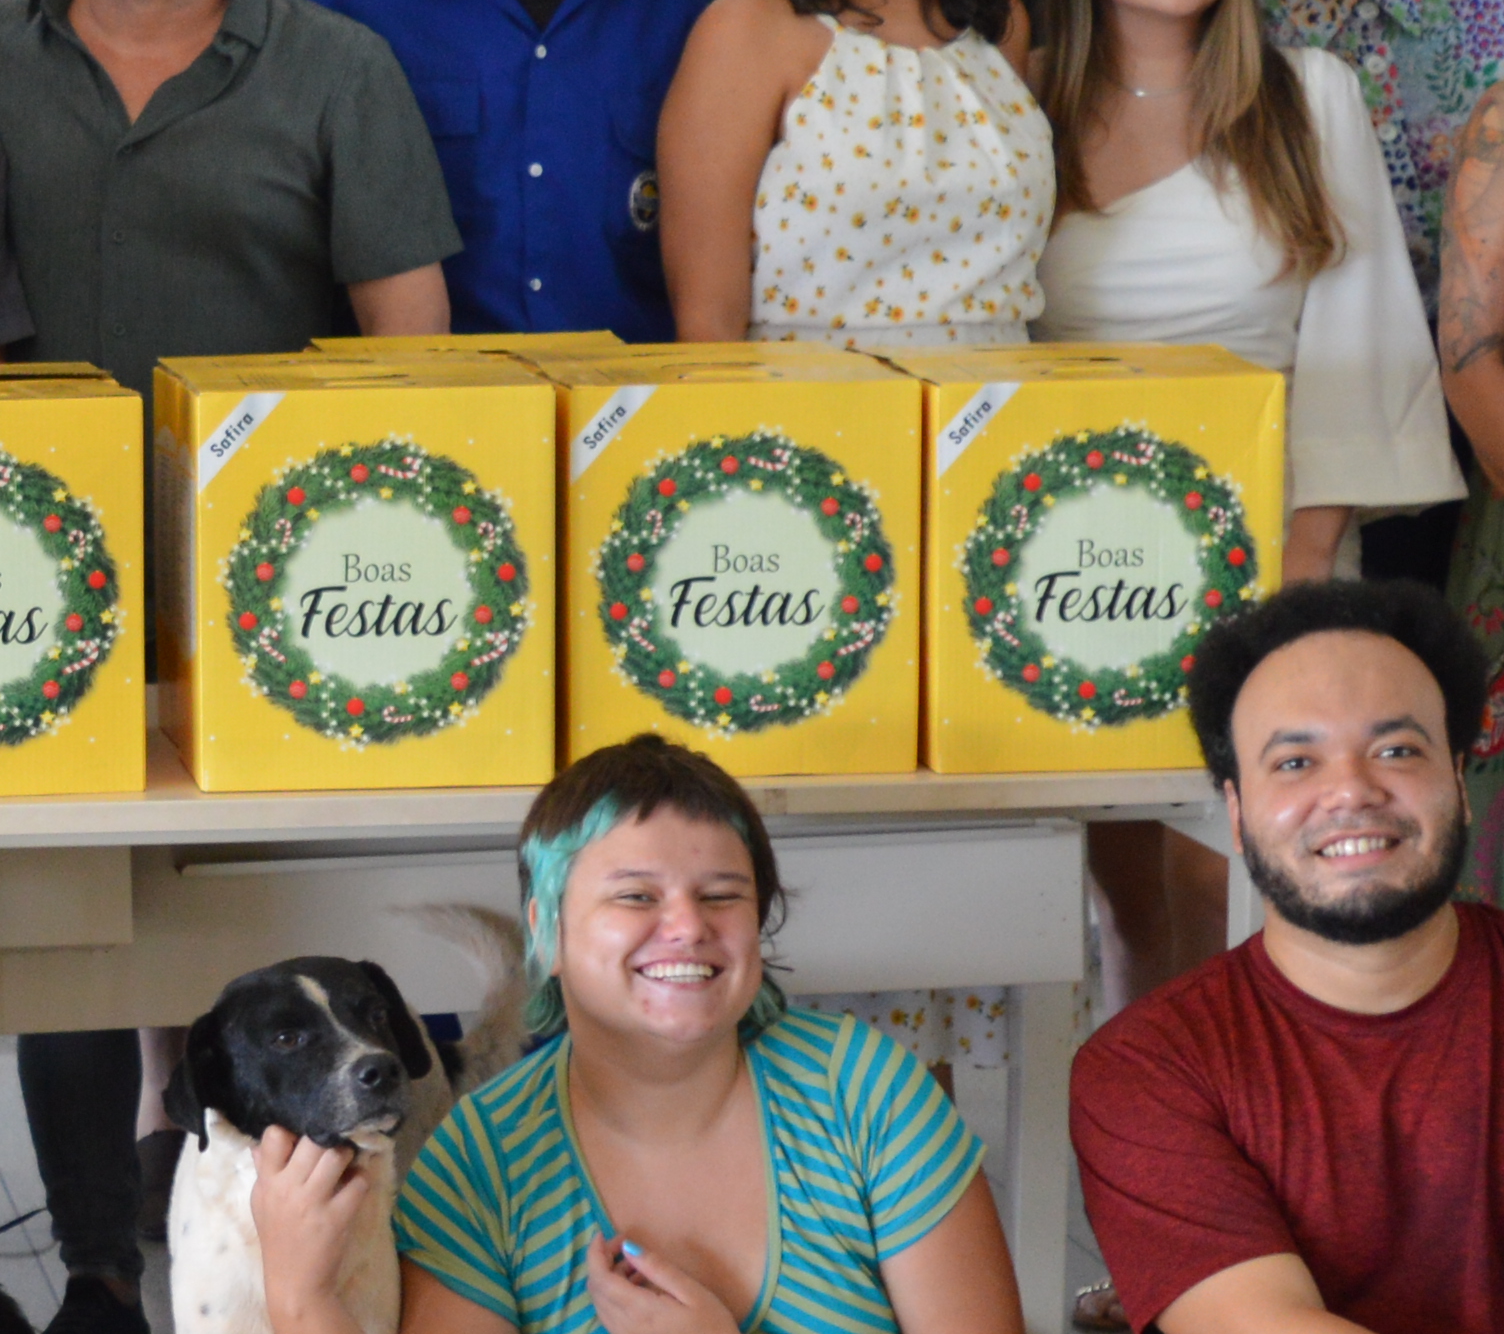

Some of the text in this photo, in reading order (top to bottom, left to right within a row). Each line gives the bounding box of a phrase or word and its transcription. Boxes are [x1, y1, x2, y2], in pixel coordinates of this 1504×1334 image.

[210, 412, 254, 458] Safira
[583, 406, 627, 450] Safira
[948, 401, 992, 445] Safira
[342, 553, 412, 583] Boas
[712, 544, 780, 573] Boas
[1077, 538, 1144, 568] Boas
[300, 585, 458, 638] Festas
[670, 576, 825, 628] Festas
[1035, 571, 1189, 622] Festas
